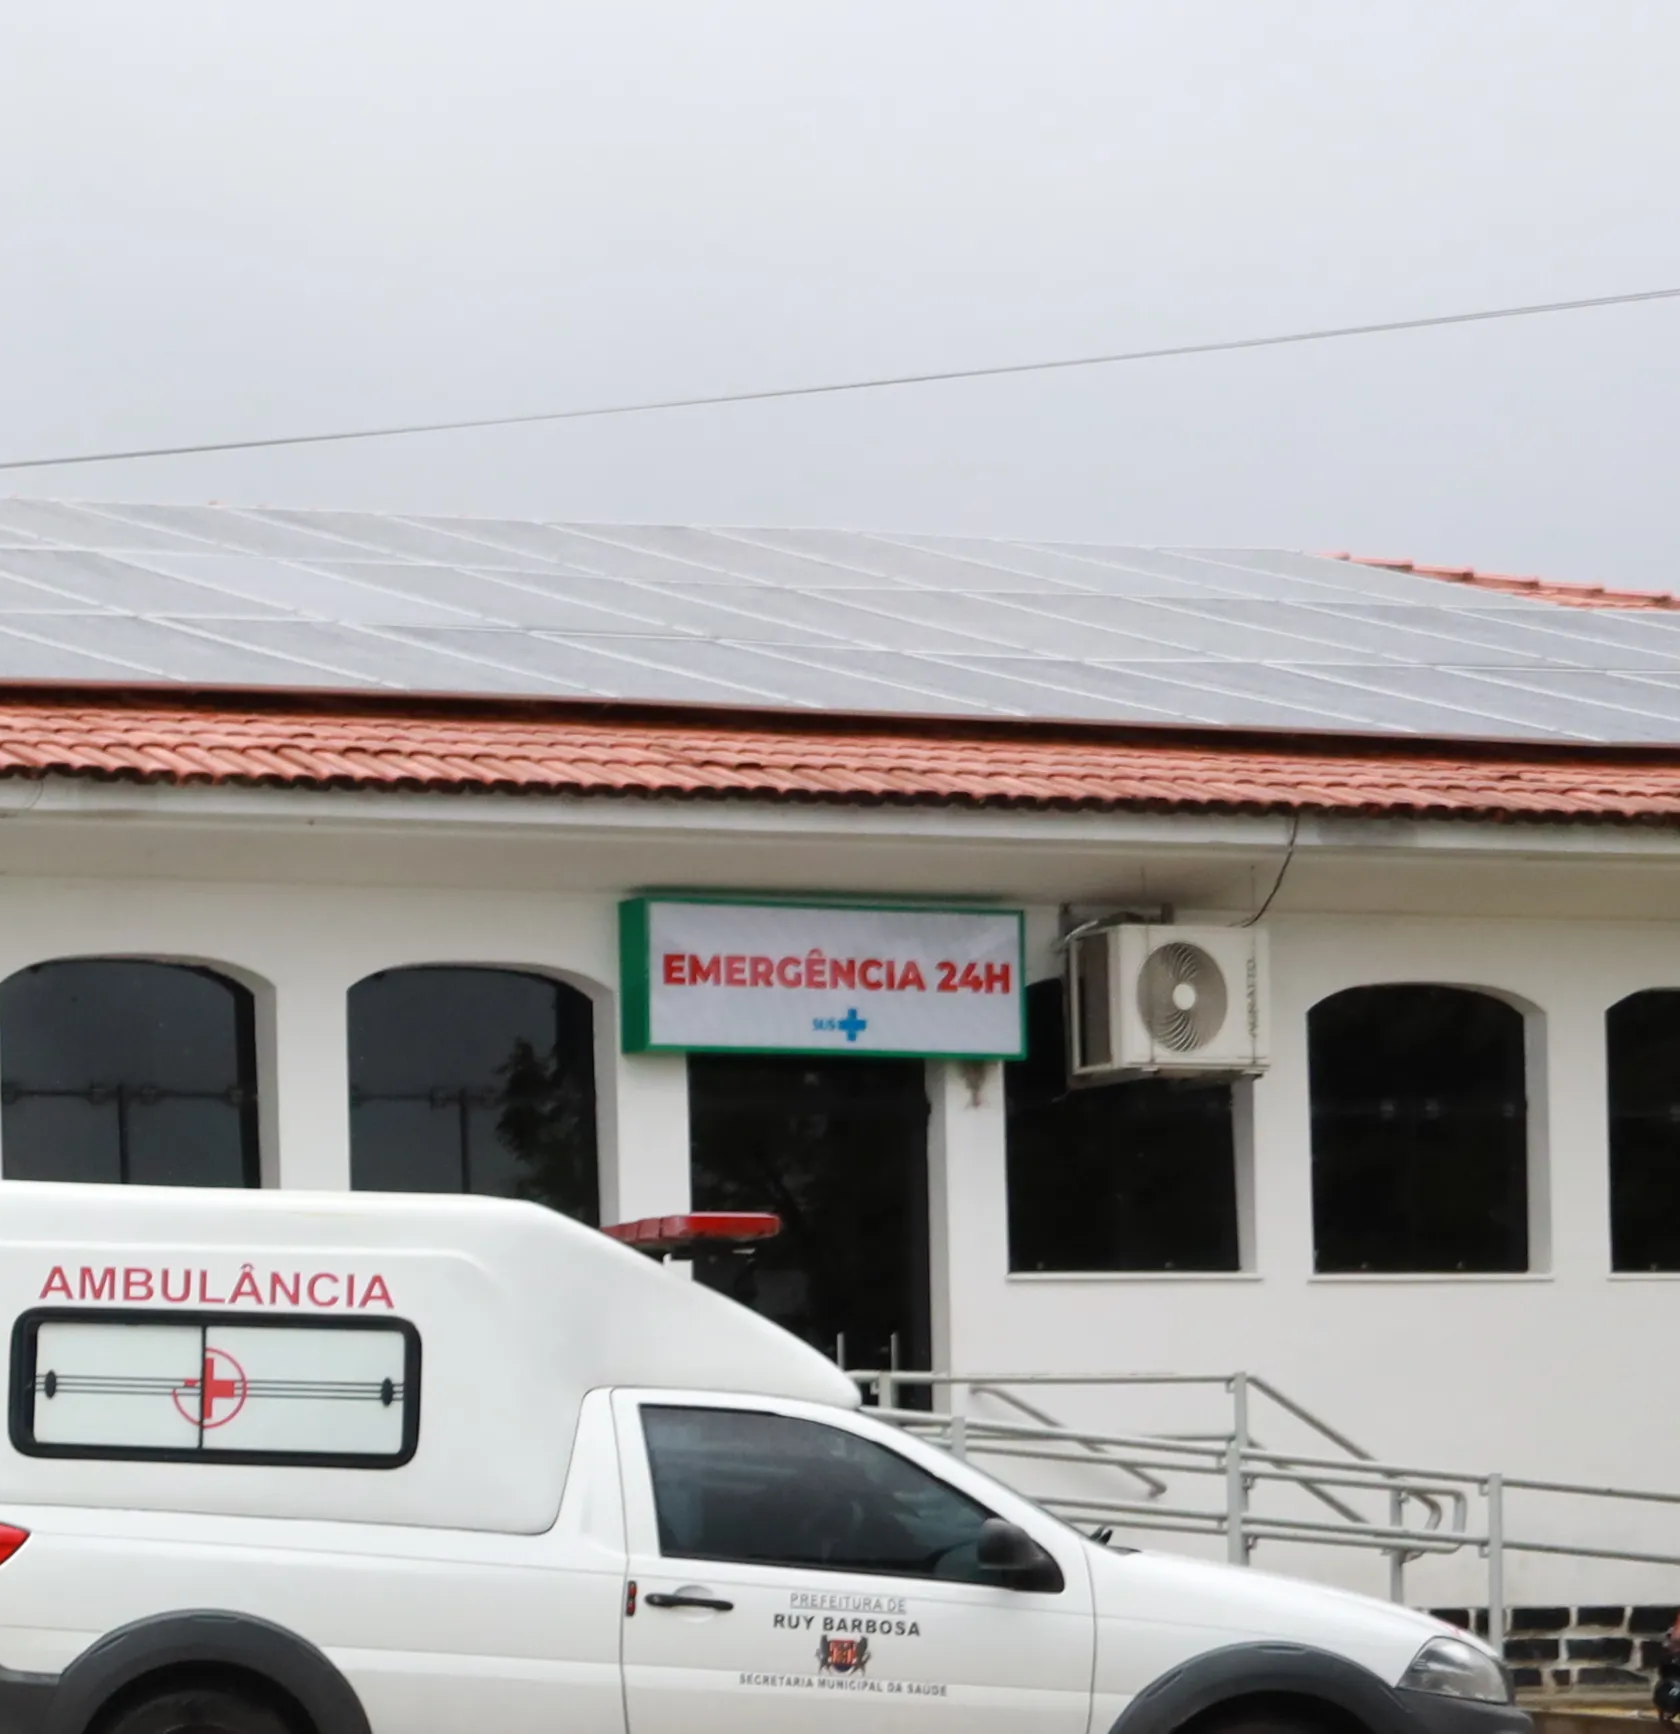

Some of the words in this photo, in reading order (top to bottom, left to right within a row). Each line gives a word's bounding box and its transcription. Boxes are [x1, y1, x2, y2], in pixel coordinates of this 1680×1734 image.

[662, 947, 926, 992] EMERGÊNCIA
[936, 959, 1011, 995] 24H
[39, 1263, 395, 1308] AMBULÂNCIA
[790, 1592, 882, 1612] PREFEITURA
[887, 1598, 908, 1614] DE
[773, 1613, 815, 1630] RUY
[823, 1616, 921, 1637] BARBOSA
[739, 1673, 814, 1689] SECRETARIA
[817, 1678, 883, 1694] MUNICIPAL
[887, 1682, 903, 1694] DA
